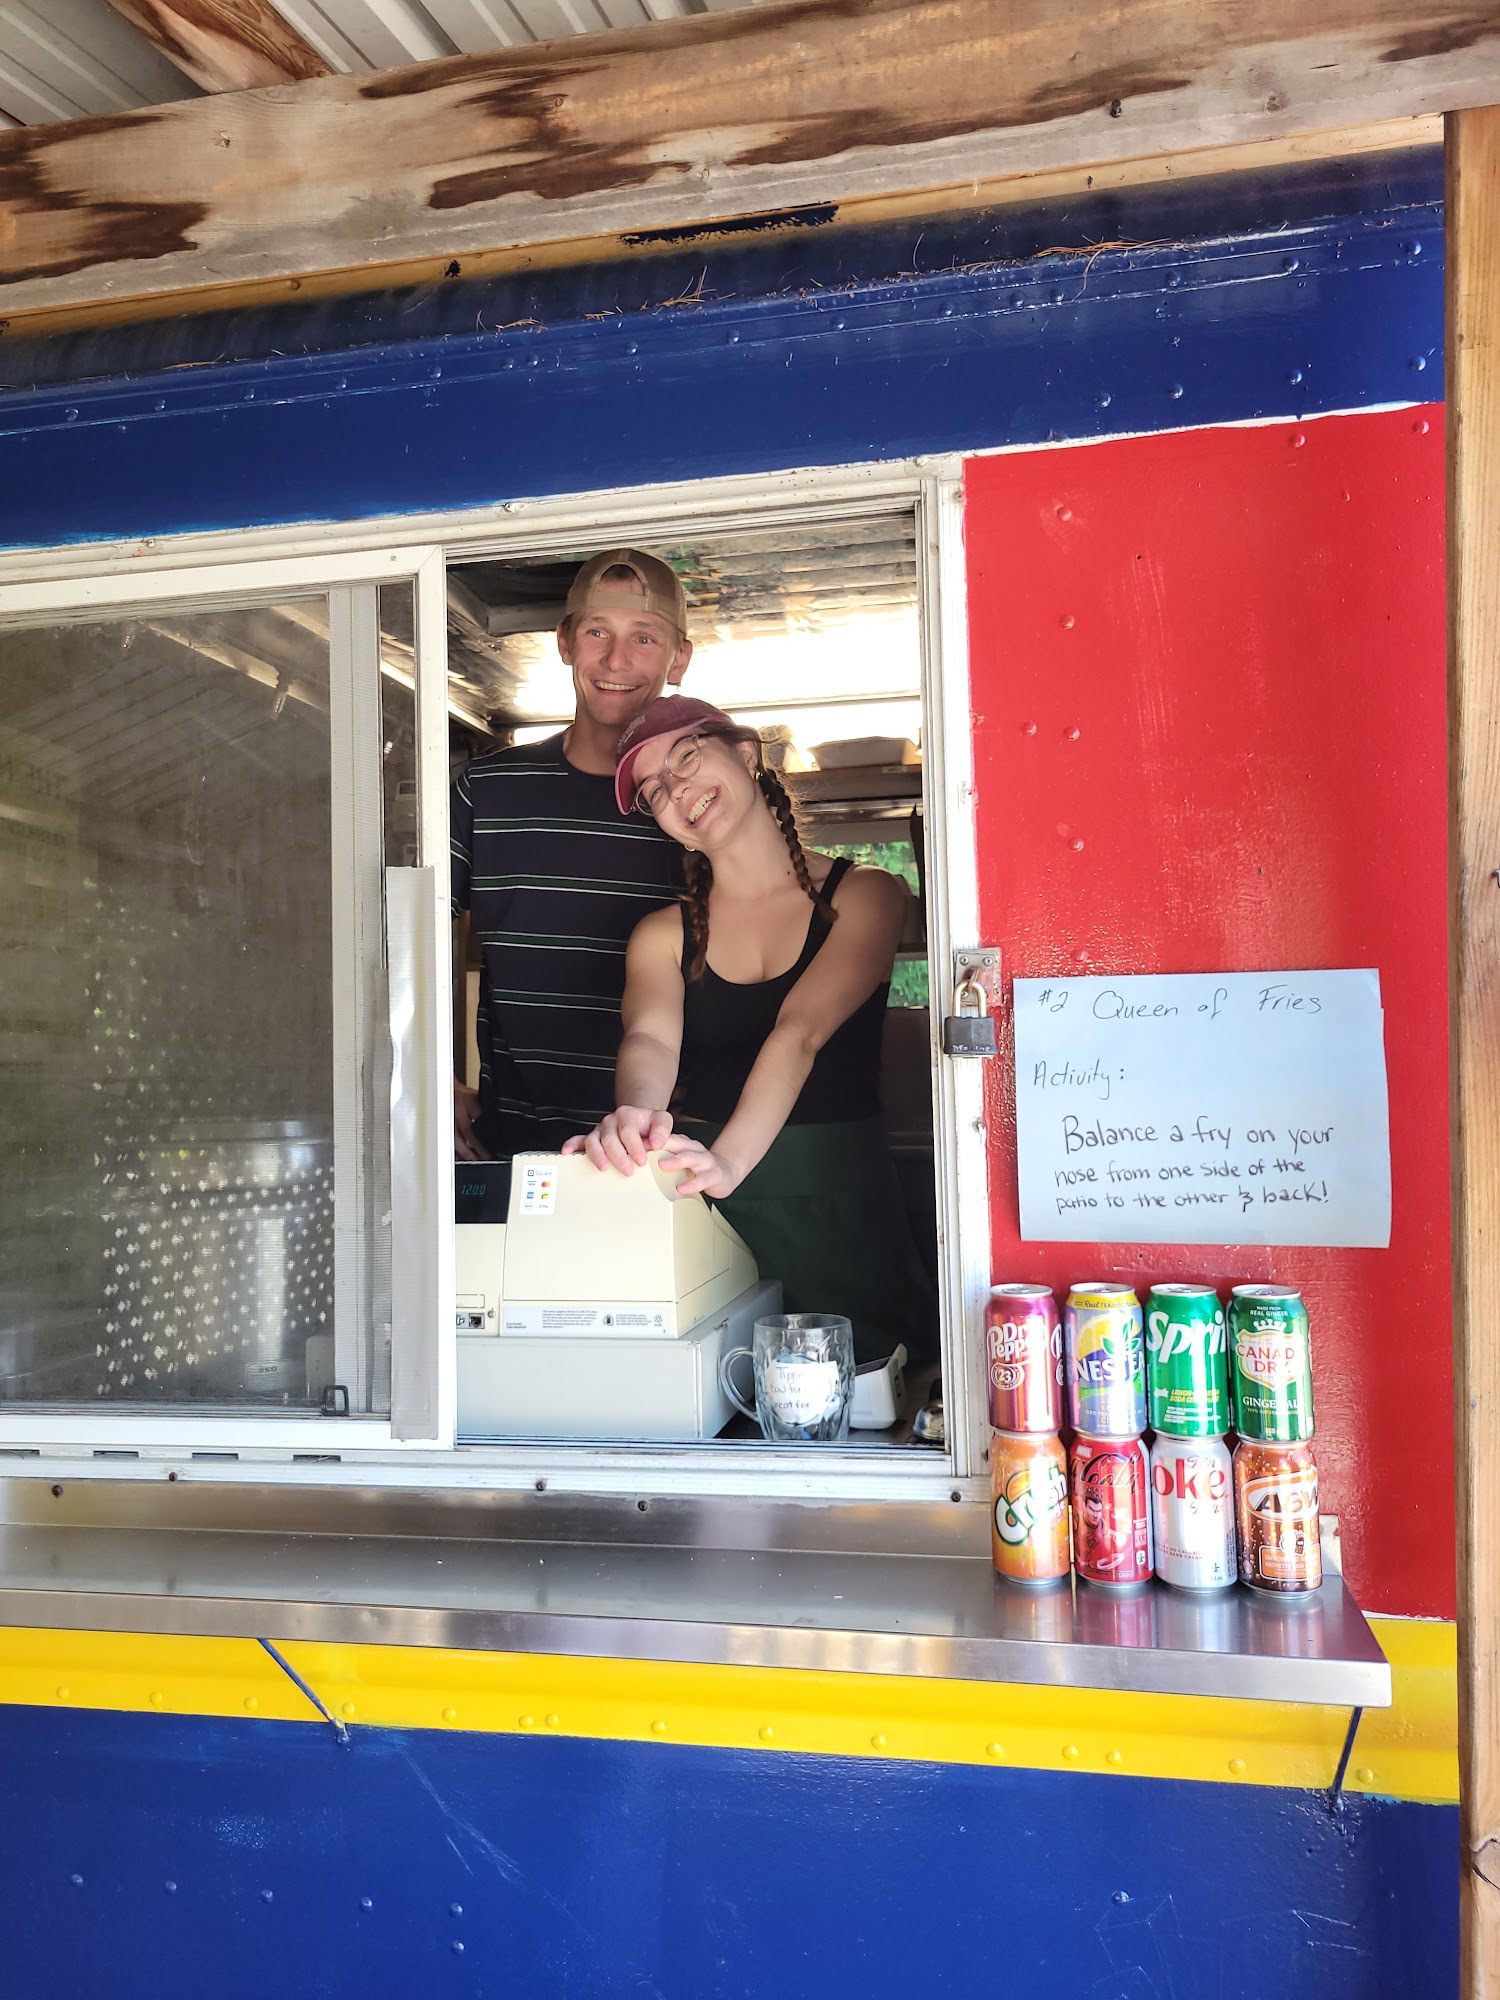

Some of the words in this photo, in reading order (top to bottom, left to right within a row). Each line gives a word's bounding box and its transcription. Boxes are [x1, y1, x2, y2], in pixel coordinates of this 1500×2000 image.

[1038, 988, 1069, 1013] #2
[1092, 990, 1179, 1020] Queen
[1197, 987, 1228, 1021] of
[1258, 984, 1323, 1013] Fries
[1033, 1058, 1125, 1101] Activity:
[1061, 1114, 1159, 1155] Balance
[1170, 1125, 1184, 1143] a
[1191, 1115, 1232, 1150] fry
[1246, 1127, 1276, 1144] on
[1287, 1125, 1335, 1155] your
[461, 1184, 487, 1195] 1200
[1054, 1166, 1100, 1188] nose
[1106, 1160, 1151, 1184] from
[1158, 1164, 1194, 1180] one
[1199, 1160, 1241, 1177] side
[1248, 1158, 1267, 1176] of
[1273, 1158, 1306, 1173] the
[1055, 1195, 1098, 1216] patio
[1103, 1193, 1125, 1209] to
[1132, 1192, 1167, 1208] the
[1174, 1190, 1228, 1206] other
[1262, 1180, 1329, 1204] back!
[986, 1325, 1042, 1362] Pepp
[1146, 1311, 1226, 1364] Spri
[1236, 1344, 1296, 1360] CANAD
[998, 1368, 1012, 1384] 23
[1242, 1396, 1283, 1409] GINGE
[1152, 1458, 1226, 1501] oke
